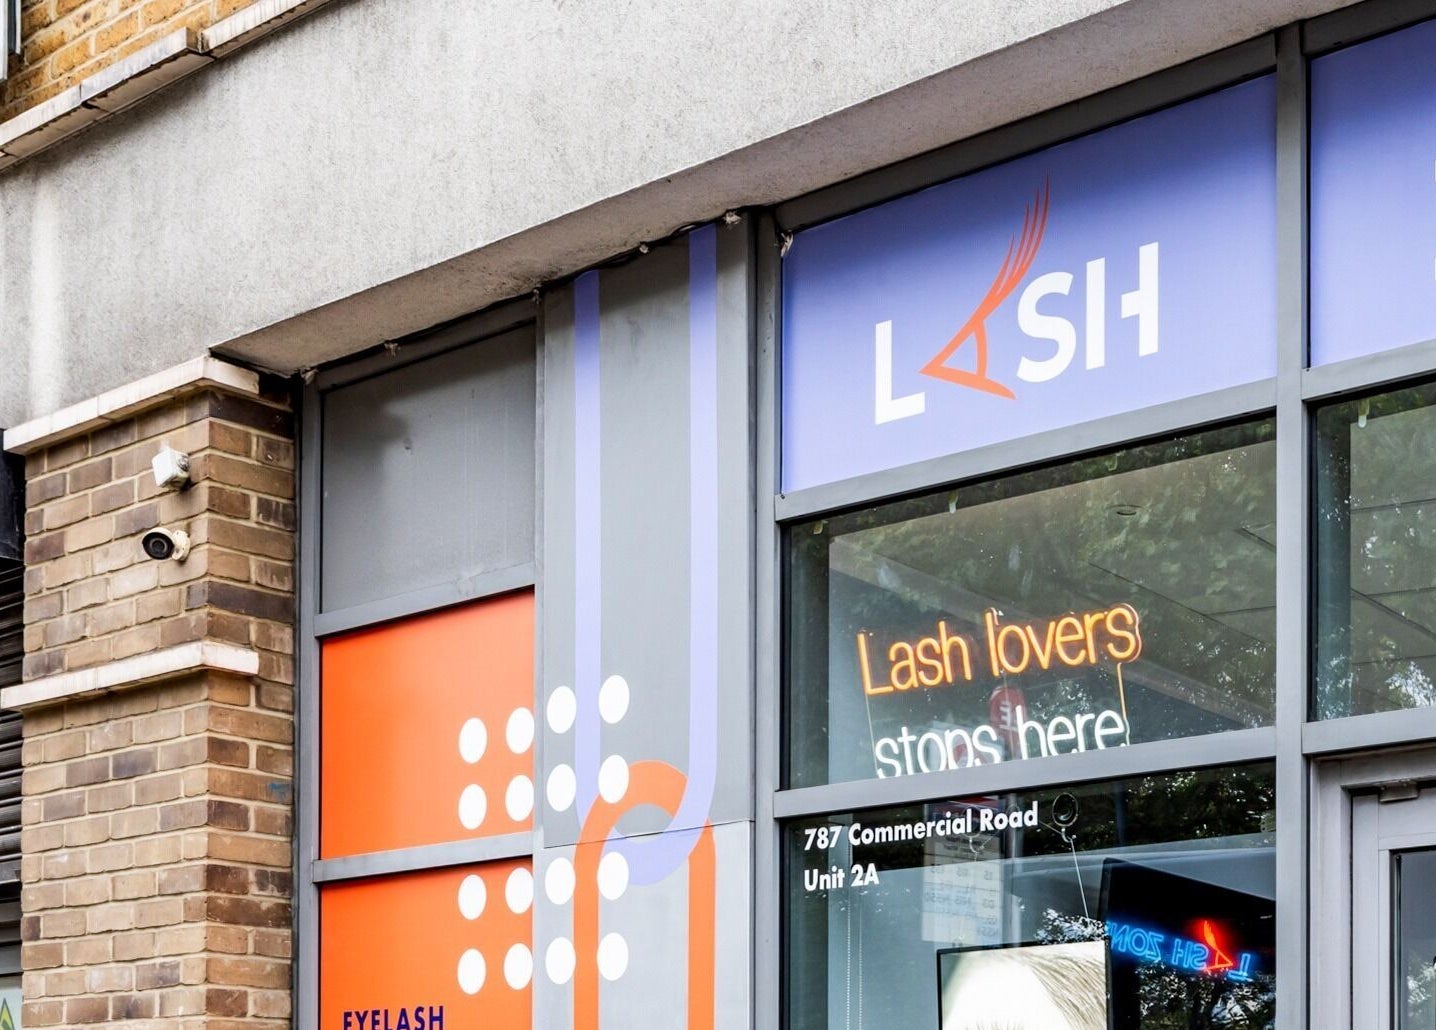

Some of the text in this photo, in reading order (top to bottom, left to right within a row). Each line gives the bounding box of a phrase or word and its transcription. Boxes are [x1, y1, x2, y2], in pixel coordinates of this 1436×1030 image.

[874, 173, 1160, 424] LASH
[857, 602, 1142, 696] Lash lovers
[875, 724, 1000, 779] stops
[1015, 705, 1127, 761] here
[803, 800, 1039, 851] 787 Commercial Road
[803, 862, 880, 892] Unit 2A
